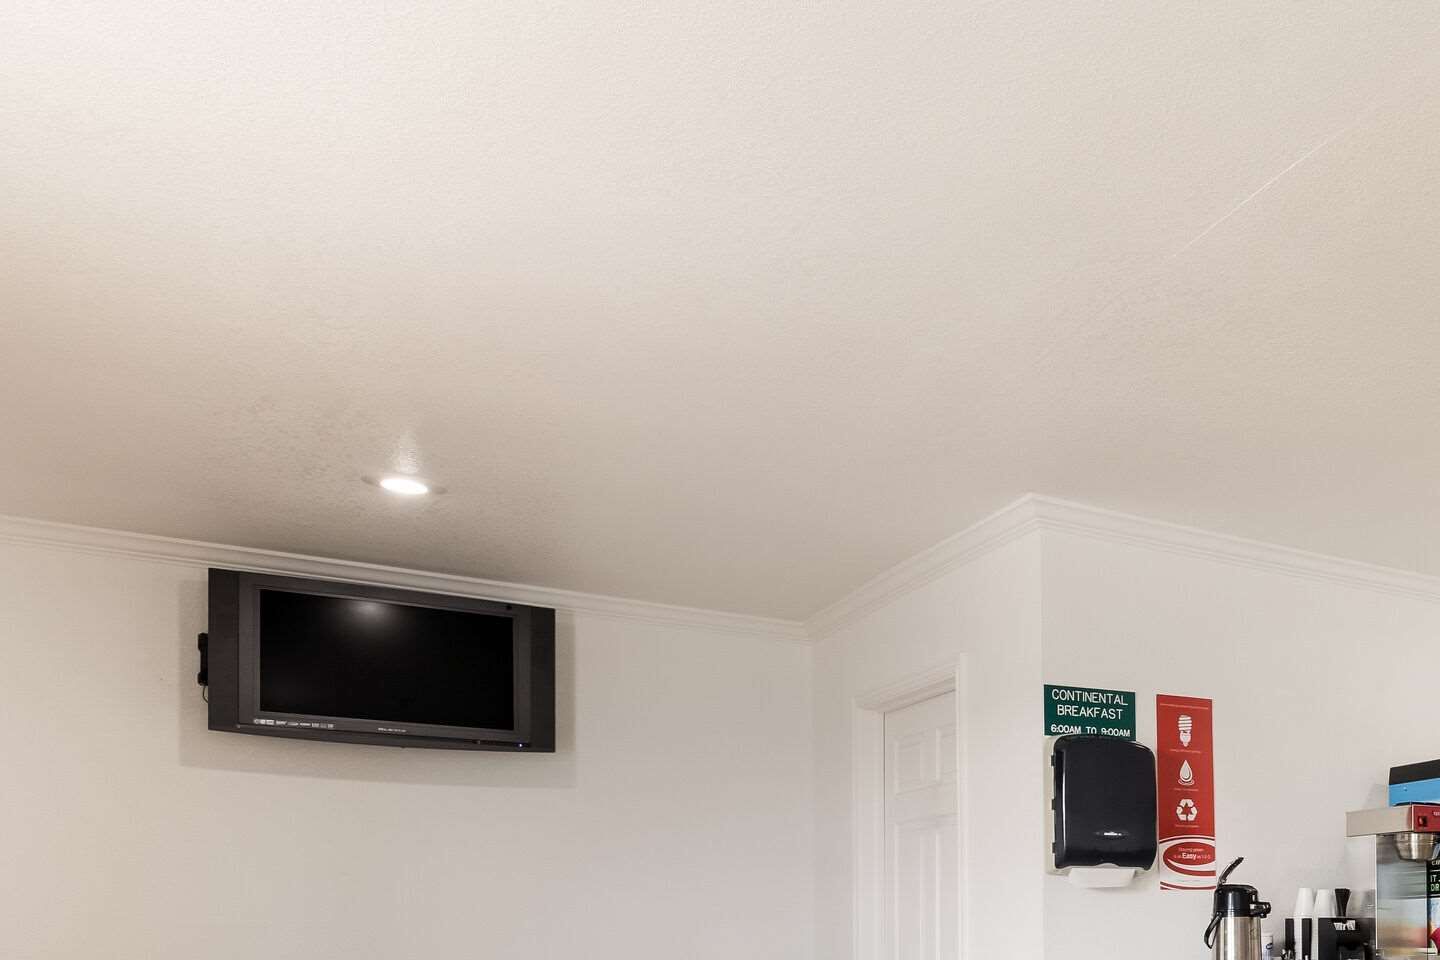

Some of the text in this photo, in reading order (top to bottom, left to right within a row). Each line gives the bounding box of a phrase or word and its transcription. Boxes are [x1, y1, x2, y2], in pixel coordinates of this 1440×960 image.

[1051, 689, 1129, 706] CONTINENTAL
[1056, 704, 1124, 720] BREAKFAST
[1050, 723, 1131, 737] 6:00AM TO 9:00AM
